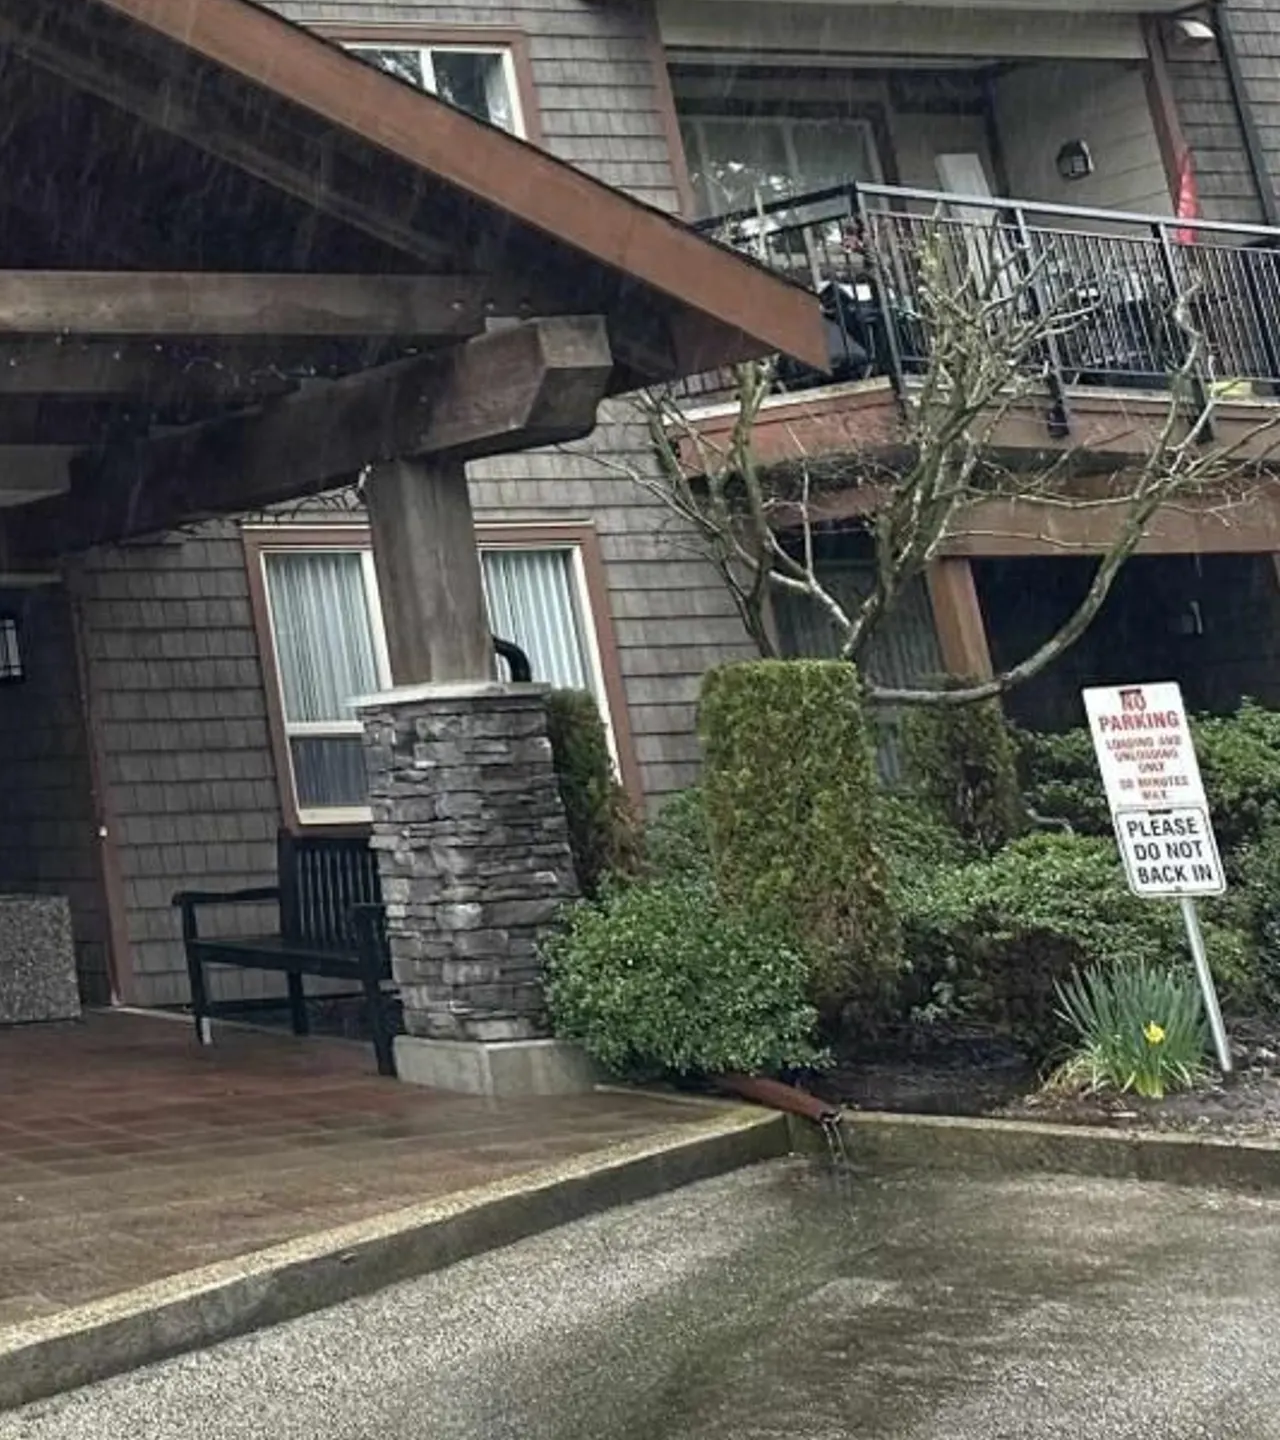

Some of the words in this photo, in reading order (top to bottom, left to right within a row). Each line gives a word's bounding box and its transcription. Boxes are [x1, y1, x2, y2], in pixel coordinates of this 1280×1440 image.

[1121, 692, 1146, 710] NO
[1098, 711, 1180, 732] PARKING
[1126, 817, 1198, 837] PLEASE
[1134, 843, 1160, 860] DO
[1166, 841, 1203, 859] NOT
[1138, 865, 1187, 884] BACK
[1192, 864, 1212, 881] IN
